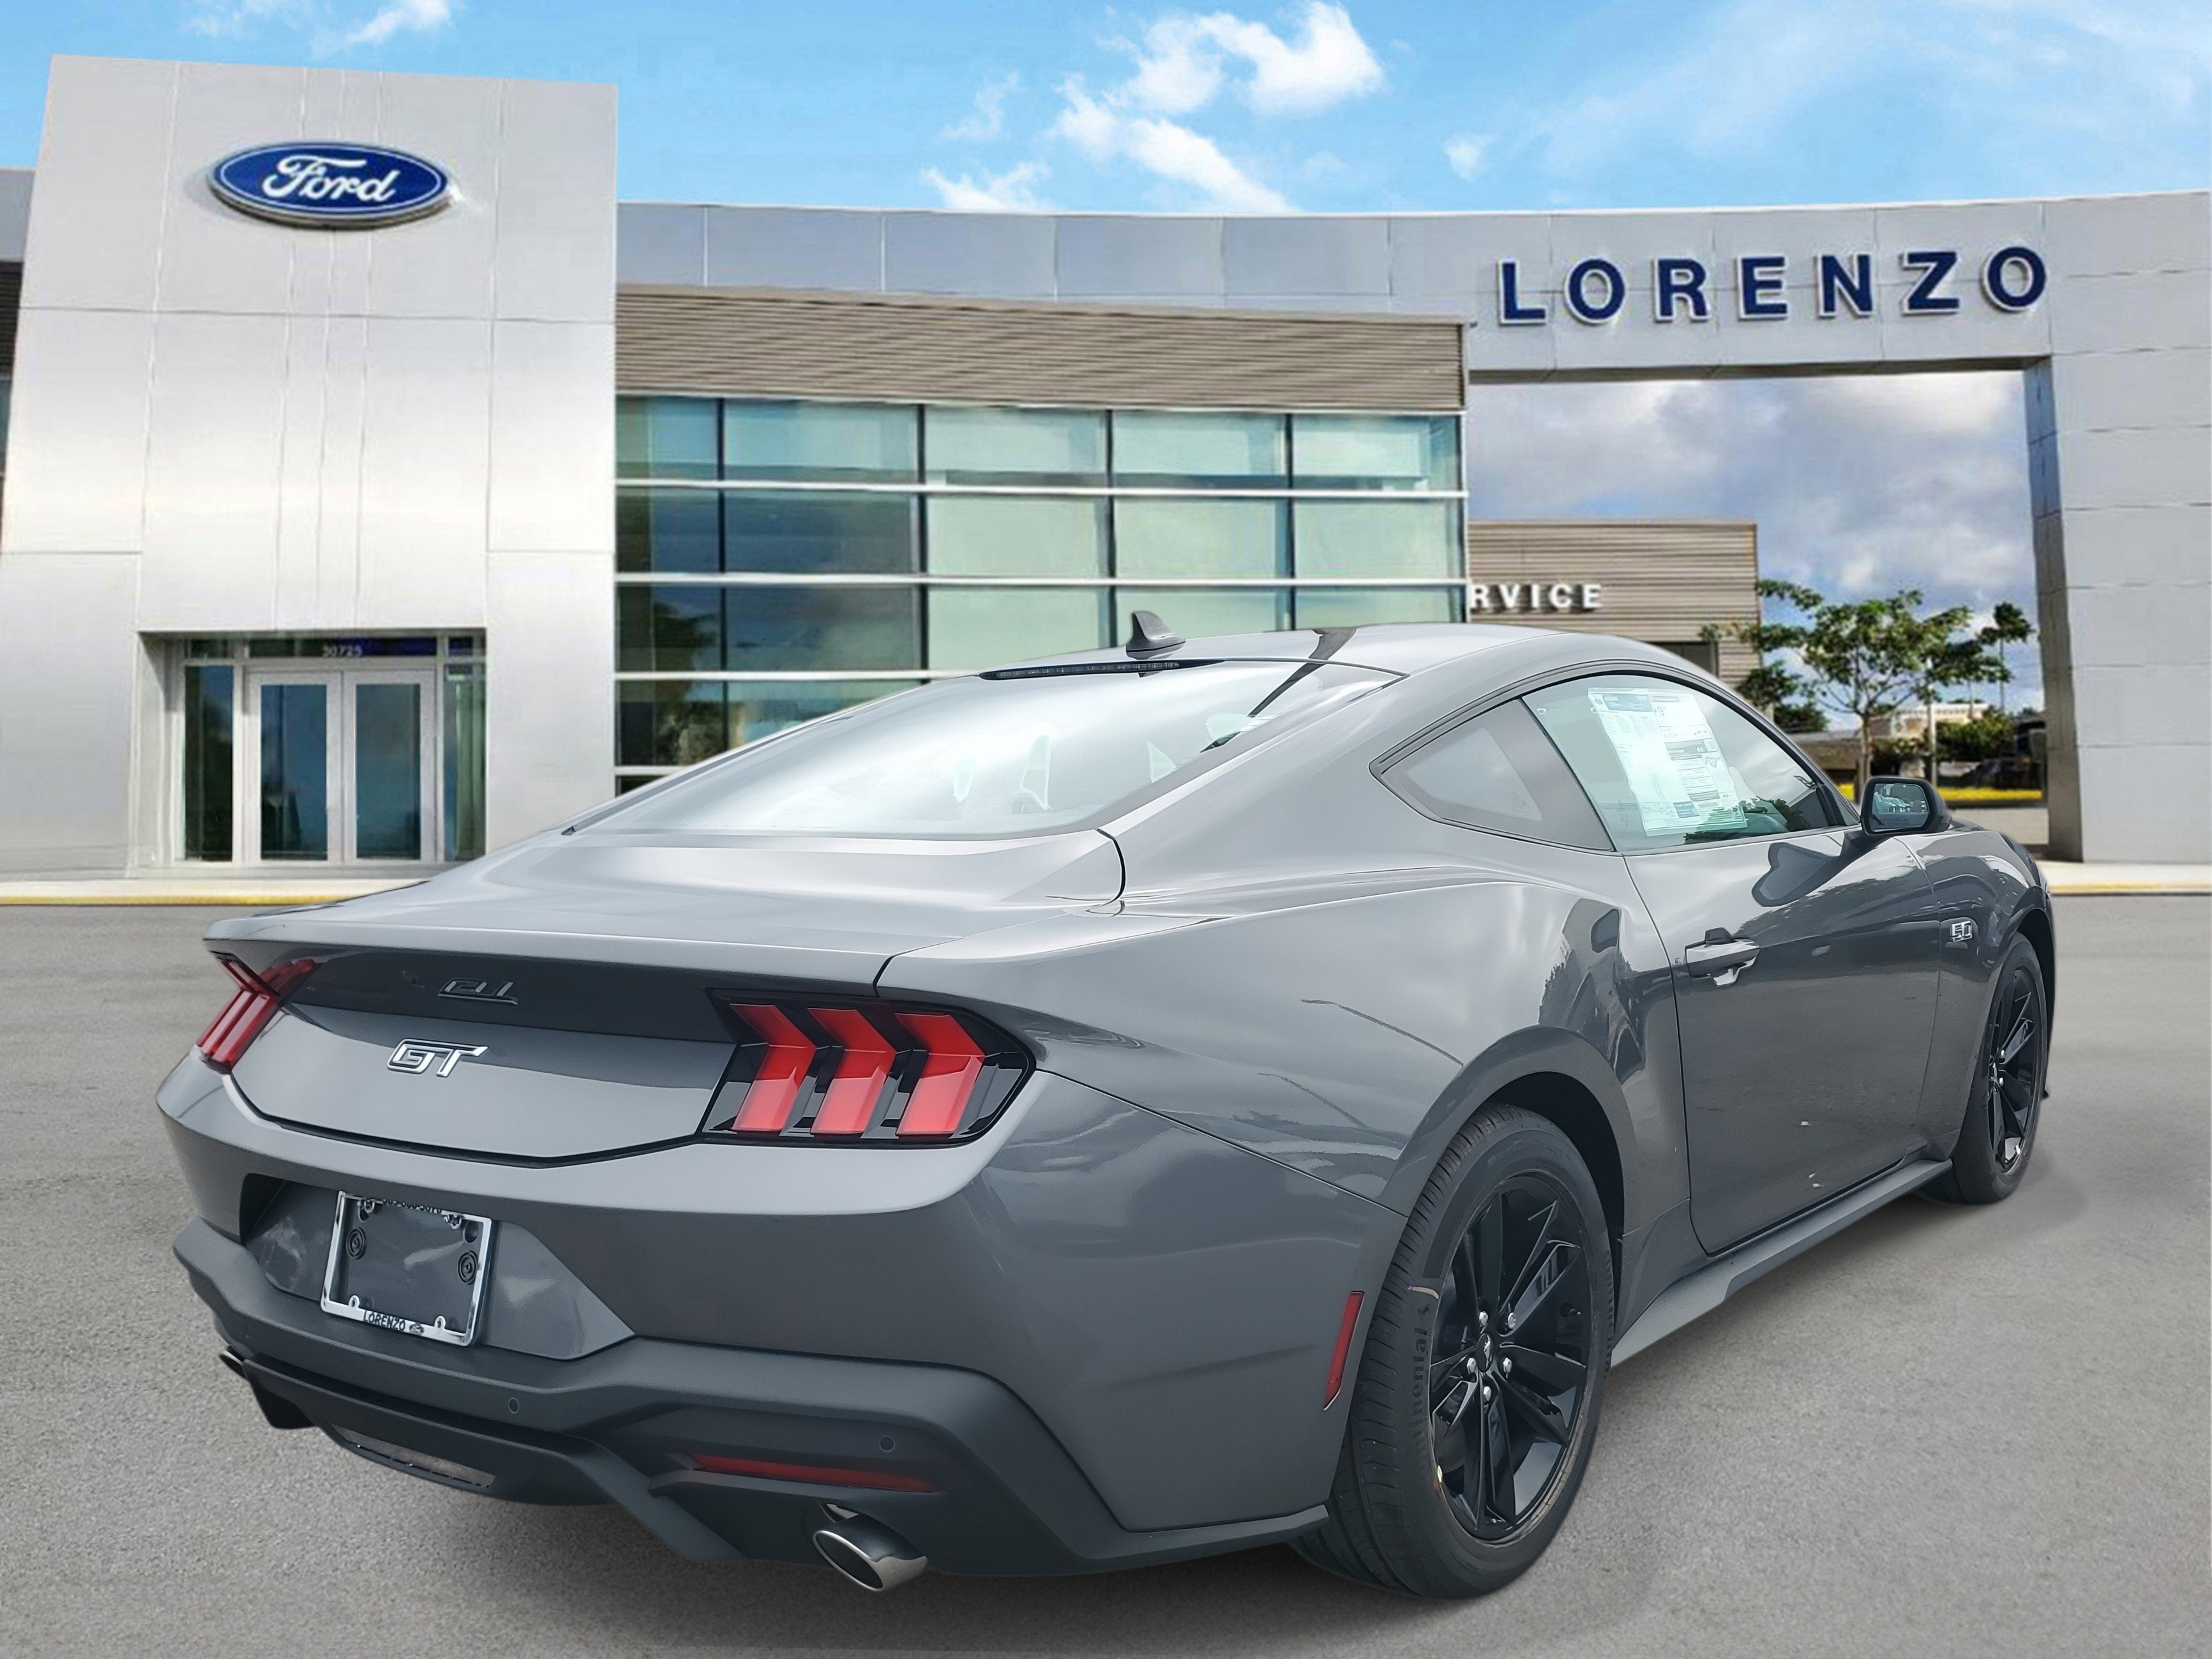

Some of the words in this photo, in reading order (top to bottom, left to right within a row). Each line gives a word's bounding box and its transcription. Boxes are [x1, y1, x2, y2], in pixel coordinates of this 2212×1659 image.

[262, 154, 400, 202] Ford
[1496, 246, 2047, 324] LORENZO
[1470, 583, 1602, 609] RVICE
[387, 1038, 489, 1078] GT
[363, 1310, 406, 1332] LORENZO
